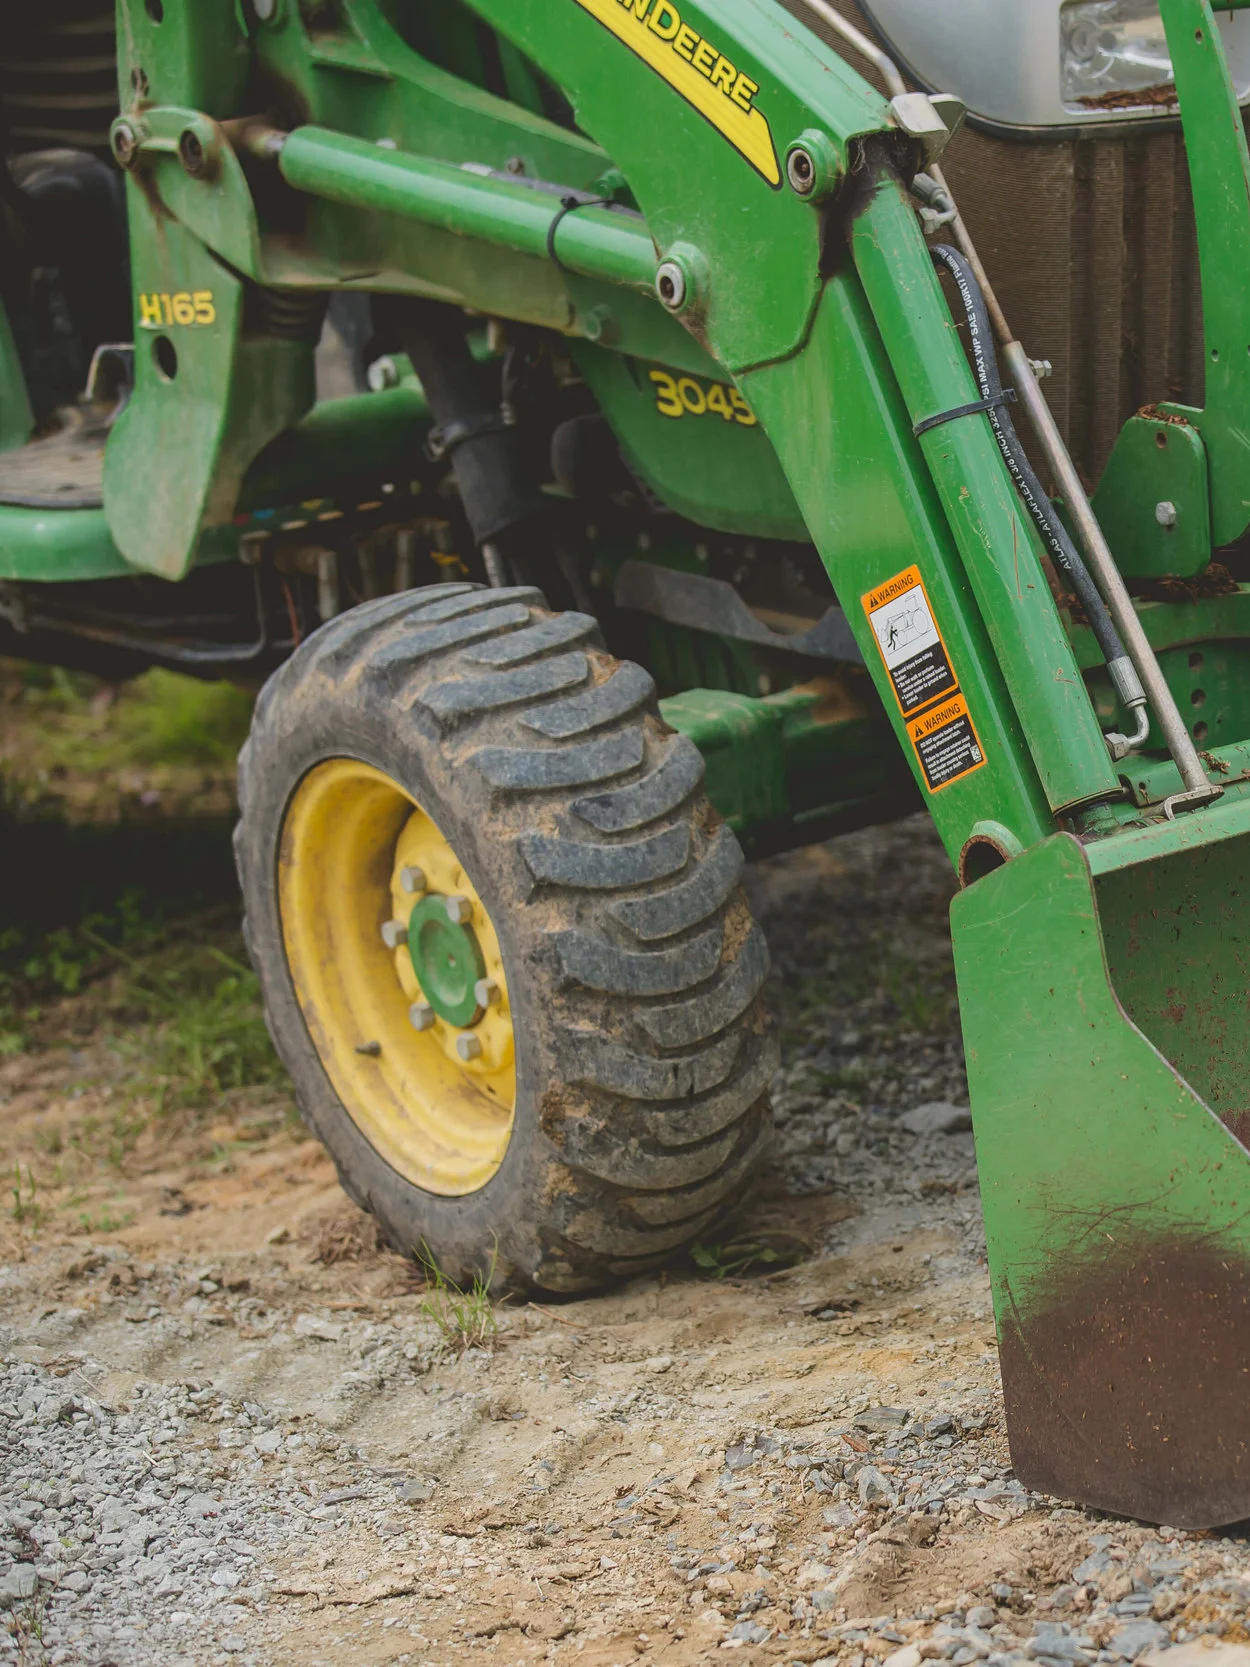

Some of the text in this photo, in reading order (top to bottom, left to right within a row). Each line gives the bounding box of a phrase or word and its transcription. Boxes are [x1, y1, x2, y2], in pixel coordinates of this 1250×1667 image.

[647, 0, 759, 114] DEERE
[957, 278, 974, 311] 100R17
[139, 290, 216, 327] H165
[968, 312, 978, 336] SAE
[971, 338, 982, 357] WP
[976, 356, 989, 382] MAX
[648, 370, 757, 425] 3045
[995, 431, 1012, 458] INCH
[1008, 458, 1019, 475] 3/8
[1019, 480, 1050, 531] ATLAFLEX
[1050, 538, 1072, 570] ATLAS
[877, 574, 914, 602] WARNING
[906, 662, 916, 670] injury
[922, 652, 933, 661] falling
[914, 685, 924, 693] loader
[927, 677, 939, 686] ground
[924, 704, 960, 730] WARNING
